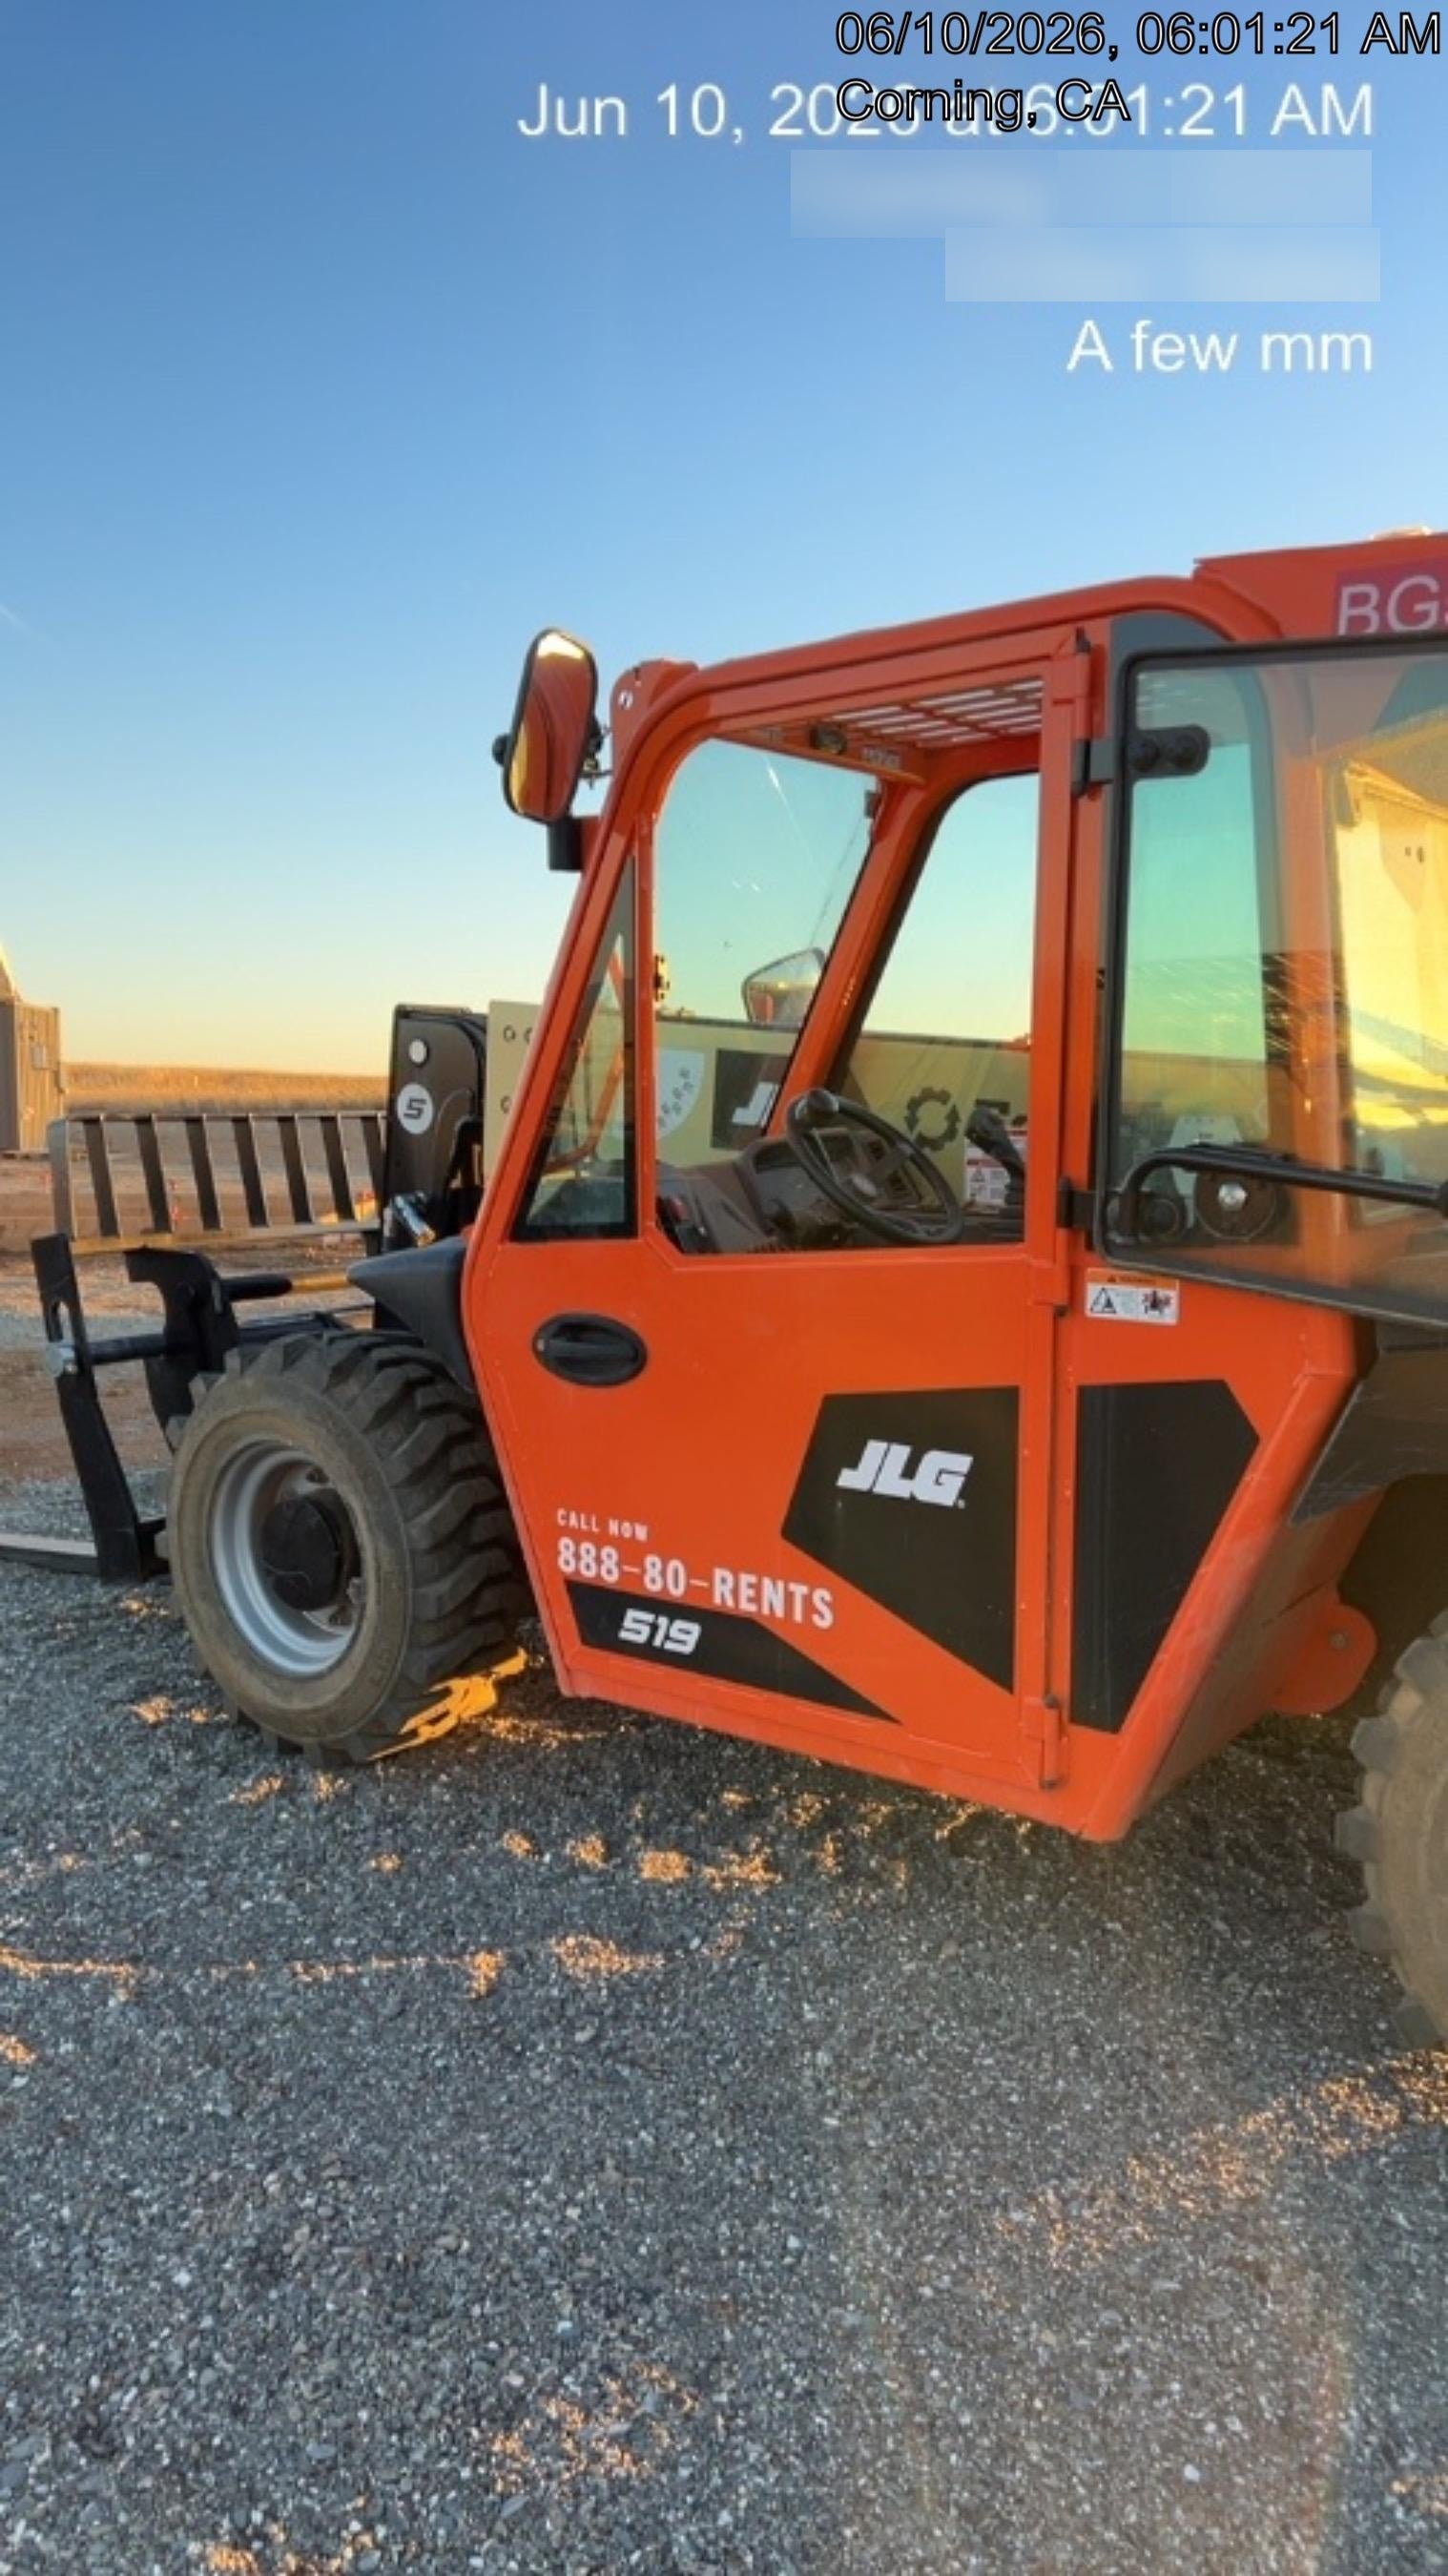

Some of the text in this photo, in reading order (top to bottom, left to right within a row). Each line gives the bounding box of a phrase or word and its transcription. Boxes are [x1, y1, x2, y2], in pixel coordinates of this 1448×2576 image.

[1338, 575, 1448, 635] BG
[836, 1440, 973, 1507] JLG
[557, 1507, 648, 1542] CALL NOW
[557, 1535, 834, 1630] 888-80-RENTS
[618, 1609, 701, 1655] 519
